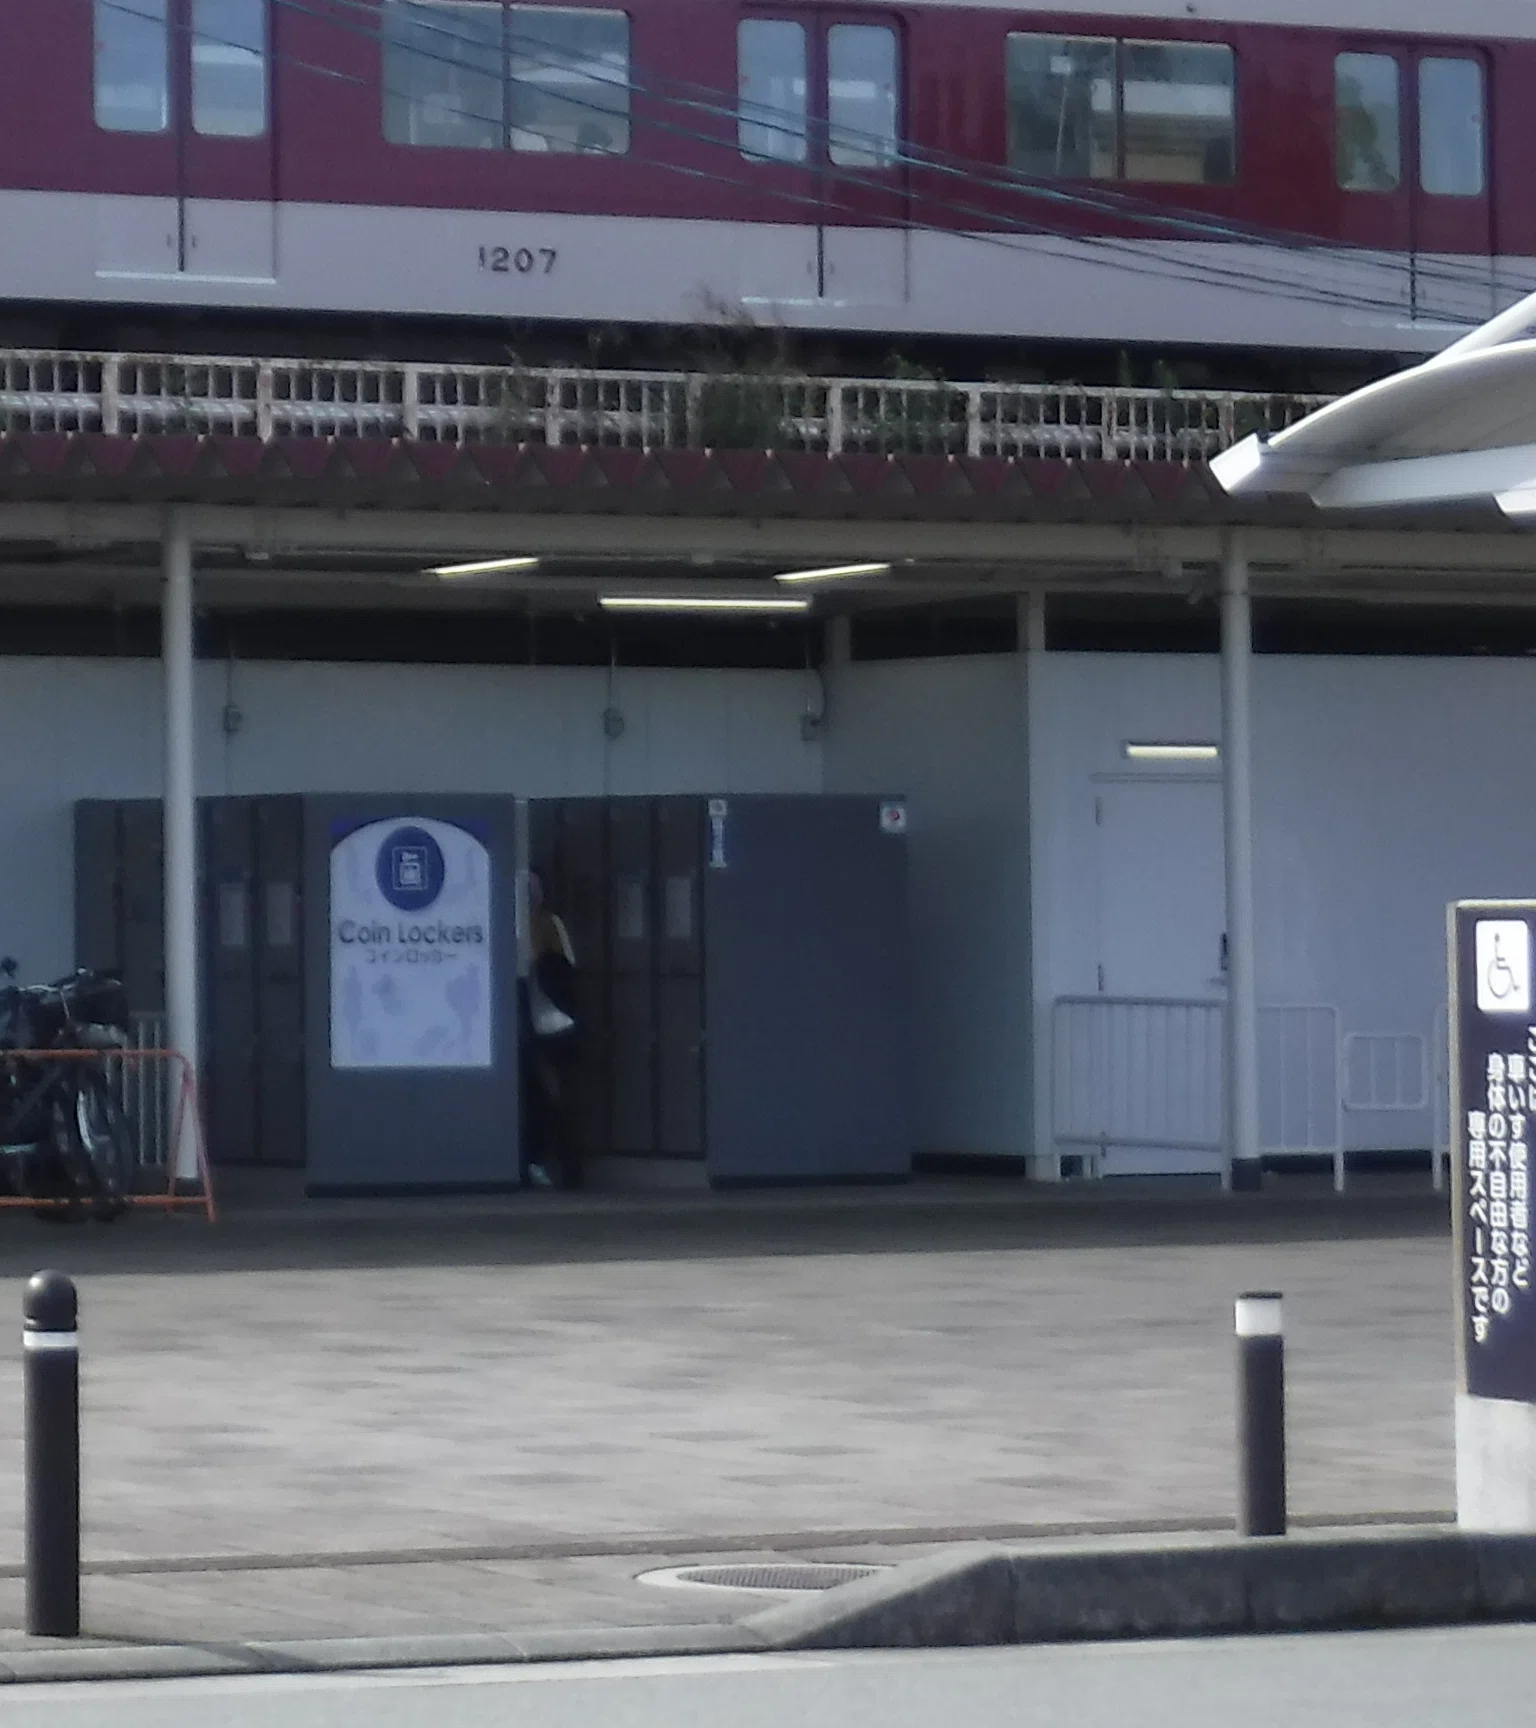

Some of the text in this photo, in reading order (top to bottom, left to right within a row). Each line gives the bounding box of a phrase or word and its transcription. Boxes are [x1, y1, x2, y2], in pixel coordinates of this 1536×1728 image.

[478, 246, 556, 273] 1207
[338, 918, 484, 944] Coin Lockers
[1467, 1110, 1489, 1343] 専用スペースです
[1486, 1052, 1510, 1314] 身体の不自由な方の
[1507, 1053, 1529, 1286] 車いす使用者など
